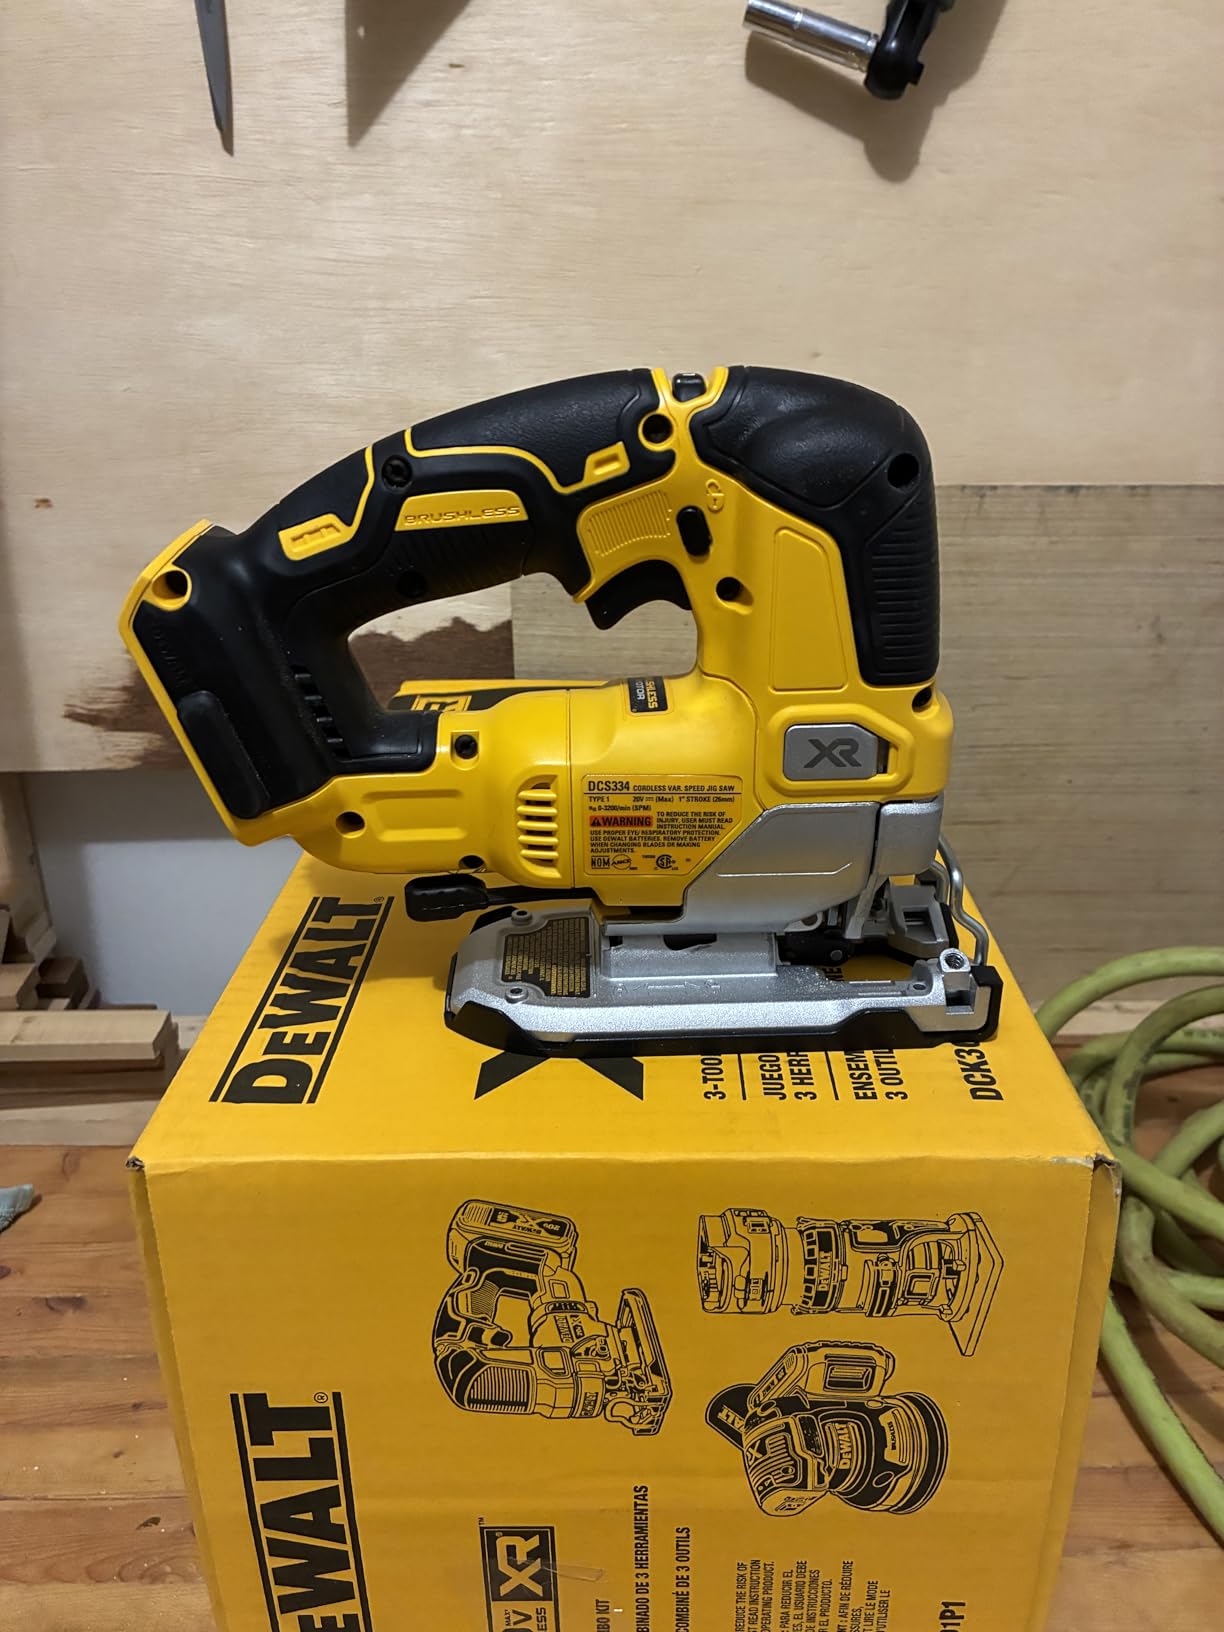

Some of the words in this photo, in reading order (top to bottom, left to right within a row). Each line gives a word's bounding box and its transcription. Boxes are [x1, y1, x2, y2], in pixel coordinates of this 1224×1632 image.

[403, 506, 520, 526] BRUSHLESS
[803, 738, 862, 768] XR
[588, 781, 630, 792] DCS334
[632, 804, 652, 812] (SPM)
[602, 816, 652, 827] WARNING
[591, 856, 610, 868] NOM
[221, 896, 383, 1105] DEWALT
[701, 1054, 726, 1100] 3-TOO
[758, 1055, 787, 1100] JUEGO
[794, 1092, 817, 1100] 3
[885, 1091, 908, 1100] 3
[819, 1250, 832, 1291] DEWALT
[838, 1423, 852, 1470] DEWALT
[633, 1485, 649, 1570] HERRAMIENTAS
[675, 1526, 691, 1563] OUTILS
[496, 1534, 543, 1597] XR
[737, 1562, 749, 1571] OF
[783, 1569, 794, 1578] EL
[796, 1560, 808, 1579] DEBE
[675, 1575, 690, 1588] DE
[736, 1573, 748, 1589] RISK
[749, 1559, 761, 1605] INSTRUCTION
[762, 1561, 775, 1595] PRODUCT.
[839, 1560, 853, 1590] RÉDUIRE
[635, 1582, 650, 1595] DE
[736, 1591, 747, 1604] THE
[781, 1580, 793, 1609] REDUCIR
[794, 1581, 806, 1611] USUARIO
[806, 1569, 820, 1623] INSTRUCCIONES
[820, 1578, 833, 1617] PRODUCTO.
[840, 1592, 851, 1602] DE
[866, 1580, 879, 1601] MODE
[879, 1589, 891, 1598] LE
[595, 1599, 610, 1615] KIT
[635, 1597, 650, 1632] BINADO
[838, 1603, 850, 1618] AFIN
[865, 1602, 877, 1611] LE
[735, 1605, 746, 1632] REDUCE
[748, 1607, 759, 1625] READ
[779, 1611, 790, 1629] PARA
[793, 1612, 804, 1620] EL
[819, 1618, 830, 1627] EL
[863, 1612, 875, 1627] LIRE
[939, 1601, 966, 1632] 1P1
